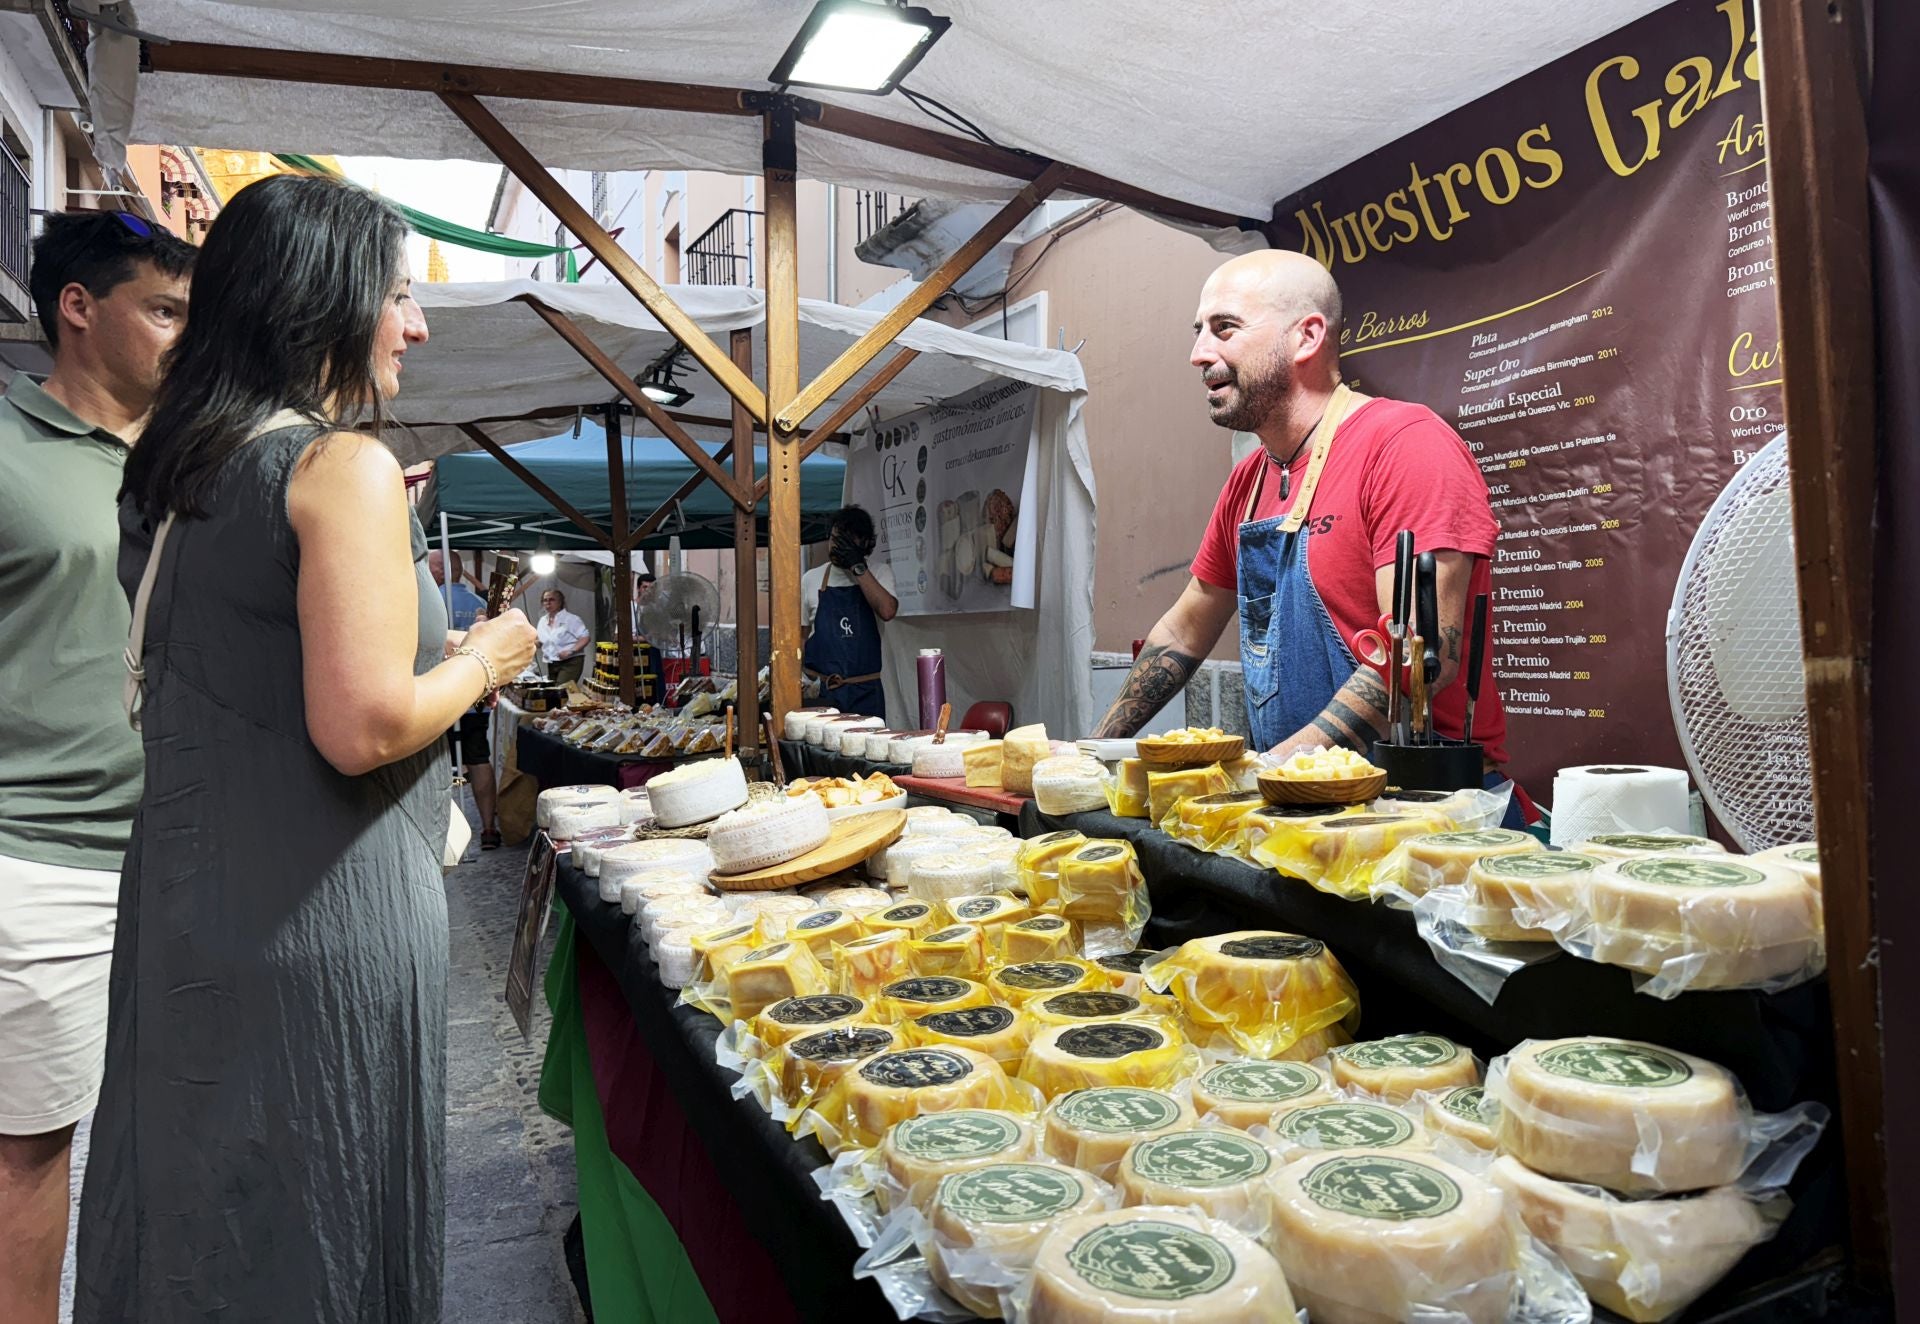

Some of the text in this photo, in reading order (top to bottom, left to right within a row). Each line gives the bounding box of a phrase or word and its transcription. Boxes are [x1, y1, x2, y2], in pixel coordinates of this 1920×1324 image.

[1716, 114, 1766, 164] Añ
[1295, 123, 1563, 273] Nuestros
[1726, 181, 1770, 208] Bronc
[1728, 200, 1771, 223] World Chee
[1728, 217, 1772, 243] Bronc
[1728, 239, 1764, 258] Concurso
[1728, 258, 1775, 282] Bronc
[1727, 281, 1767, 298] Concurso
[1356, 310, 1429, 342] Barros
[1469, 346, 1497, 360] Concurso
[1520, 335, 1527, 343] de
[1528, 327, 1549, 342] Quesos
[1550, 313, 1588, 332] Birmingham
[1592, 306, 1613, 319] 2012
[1471, 332, 1497, 348] Plata
[1729, 332, 1782, 377] Cu
[1461, 381, 1490, 394] Concurso
[1512, 372, 1520, 380] de
[1520, 366, 1545, 378] Quesos
[1547, 354, 1593, 371] Birmingham
[1598, 348, 1618, 360] 2011
[1464, 358, 1520, 382] Super Oro
[1458, 382, 1562, 418] Mención Especial
[1459, 395, 1595, 430] Concurso Nacional de Quesos Vic 2010
[1730, 406, 1767, 421] Oro
[932, 417, 994, 449] gastronómicas
[1731, 423, 1787, 438] World Che
[1477, 452, 1492, 463] curso
[1494, 450, 1518, 461] Mundial
[1531, 444, 1559, 455] Quesos
[1560, 439, 1574, 450] Las
[1576, 434, 1605, 447] Palmas
[1606, 433, 1616, 441] de
[1482, 459, 1526, 473] Canaria 2009
[1490, 500, 1502, 508] urso
[1502, 495, 1527, 508] Mundial
[1529, 494, 1538, 502] de
[1539, 491, 1566, 502] Quesos
[1592, 484, 1612, 494] 2008
[1505, 530, 1529, 541] Mundial
[1530, 527, 1540, 537] de
[1541, 525, 1568, 536] Quesos
[1498, 546, 1540, 562] Premio
[1493, 558, 1604, 574] Nacional del Queso Trujillo 2005
[1500, 585, 1544, 599] Premio
[1492, 603, 1538, 612] ourmetquesos
[1540, 602, 1562, 610] Madrid
[1503, 619, 1546, 633] Premio
[1501, 636, 1529, 645] Nacional
[1530, 636, 1541, 644] del
[1542, 636, 1564, 644] Queso
[1565, 635, 1586, 645] Trujillo
[1589, 635, 1606, 643] 2003
[1492, 653, 1550, 667] er Premio
[1499, 671, 1548, 680] Gourmetquesos
[1549, 672, 1570, 680] Madrid
[1574, 672, 1590, 680] 2003
[1510, 689, 1550, 702] Premio
[1506, 705, 1531, 714] Nacional
[1533, 706, 1543, 715] del
[1544, 707, 1564, 715] Queso
[1565, 708, 1586, 718] Trujillo
